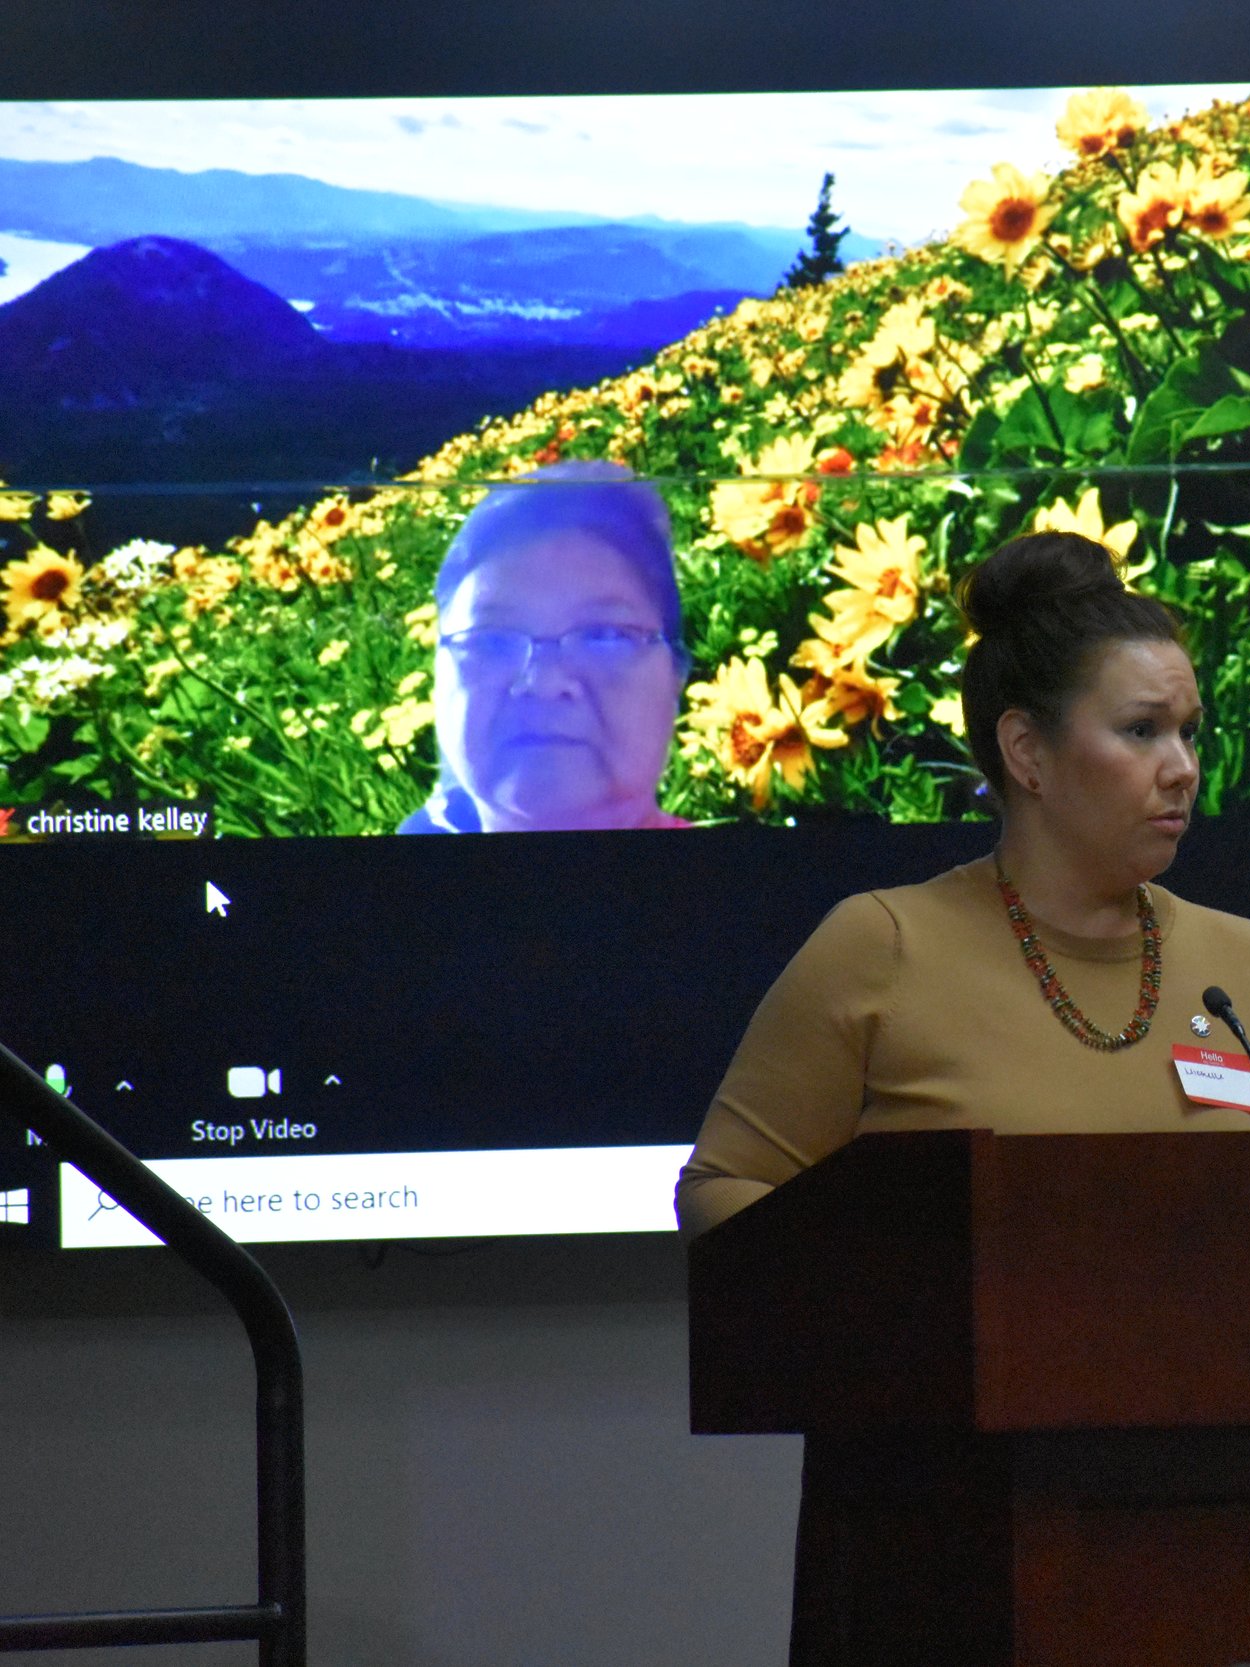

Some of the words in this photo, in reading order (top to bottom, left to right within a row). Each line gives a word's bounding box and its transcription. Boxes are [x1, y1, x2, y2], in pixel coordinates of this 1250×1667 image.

[27, 808, 130, 834] christine
[137, 806, 208, 837] kelley
[1200, 1050, 1224, 1063] Hello
[190, 1119, 246, 1147] Stop
[249, 1117, 318, 1140] Video
[222, 1189, 283, 1213] here
[293, 1189, 322, 1212] to
[331, 1184, 419, 1210] search
